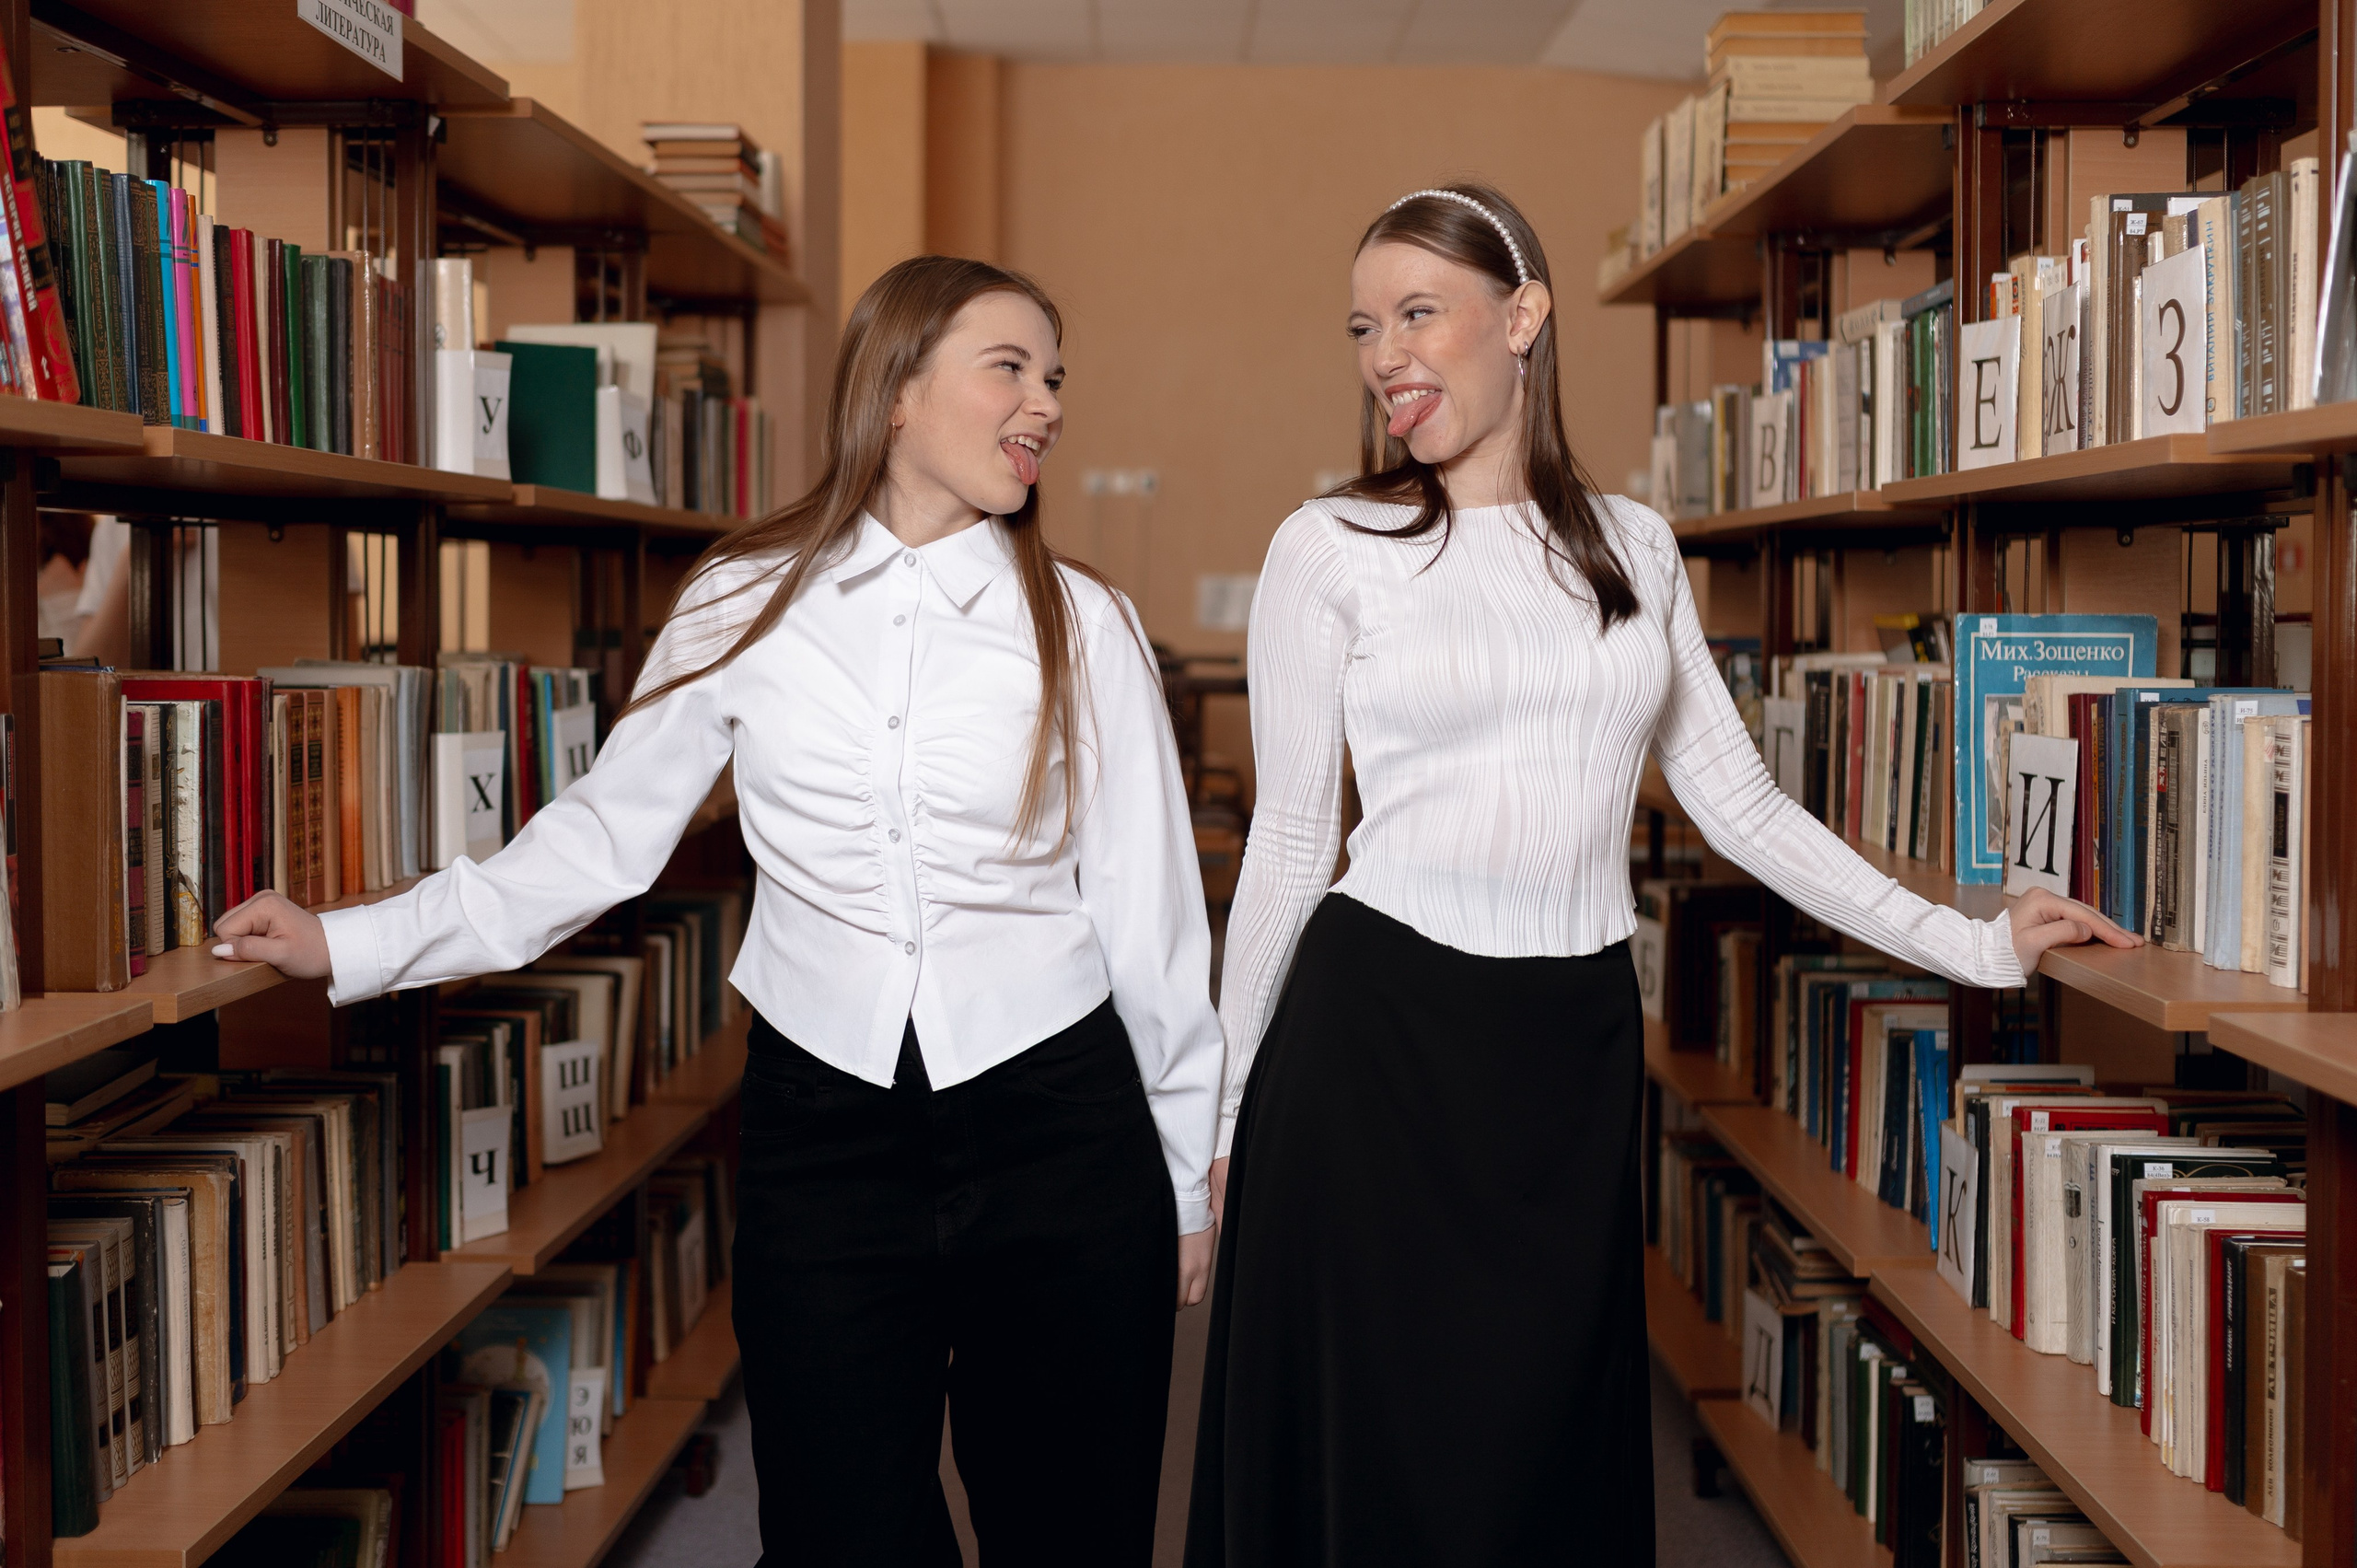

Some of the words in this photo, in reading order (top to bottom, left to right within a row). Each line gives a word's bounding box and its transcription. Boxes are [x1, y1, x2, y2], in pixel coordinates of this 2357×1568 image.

[316, 1, 386, 63] ЛИТЕРАТУРА
[3, 171, 24, 241] ИСТОРИЯ
[17, 243, 39, 312] РЕЛИГИИ
[2205, 220, 2215, 305] ЗАКРУТКИН
[2207, 311, 2215, 381] ВИТАЛИЙ
[1970, 356, 2002, 450] Е
[2048, 325, 2075, 436] Ж
[479, 396, 503, 434] У
[623, 428, 642, 459] Ф
[1759, 424, 1777, 491] В
[470, 772, 497, 814] Х
[2014, 772, 2065, 877] И
[558, 1056, 590, 1089] Ш
[562, 1102, 597, 1138] Щ
[468, 1149, 499, 1187] Ч
[1946, 1165, 1968, 1275] К
[2268, 1292, 2277, 1394] ЛЕТЧИЦА
[575, 1386, 589, 1408] Э
[573, 1445, 588, 1466] Я
